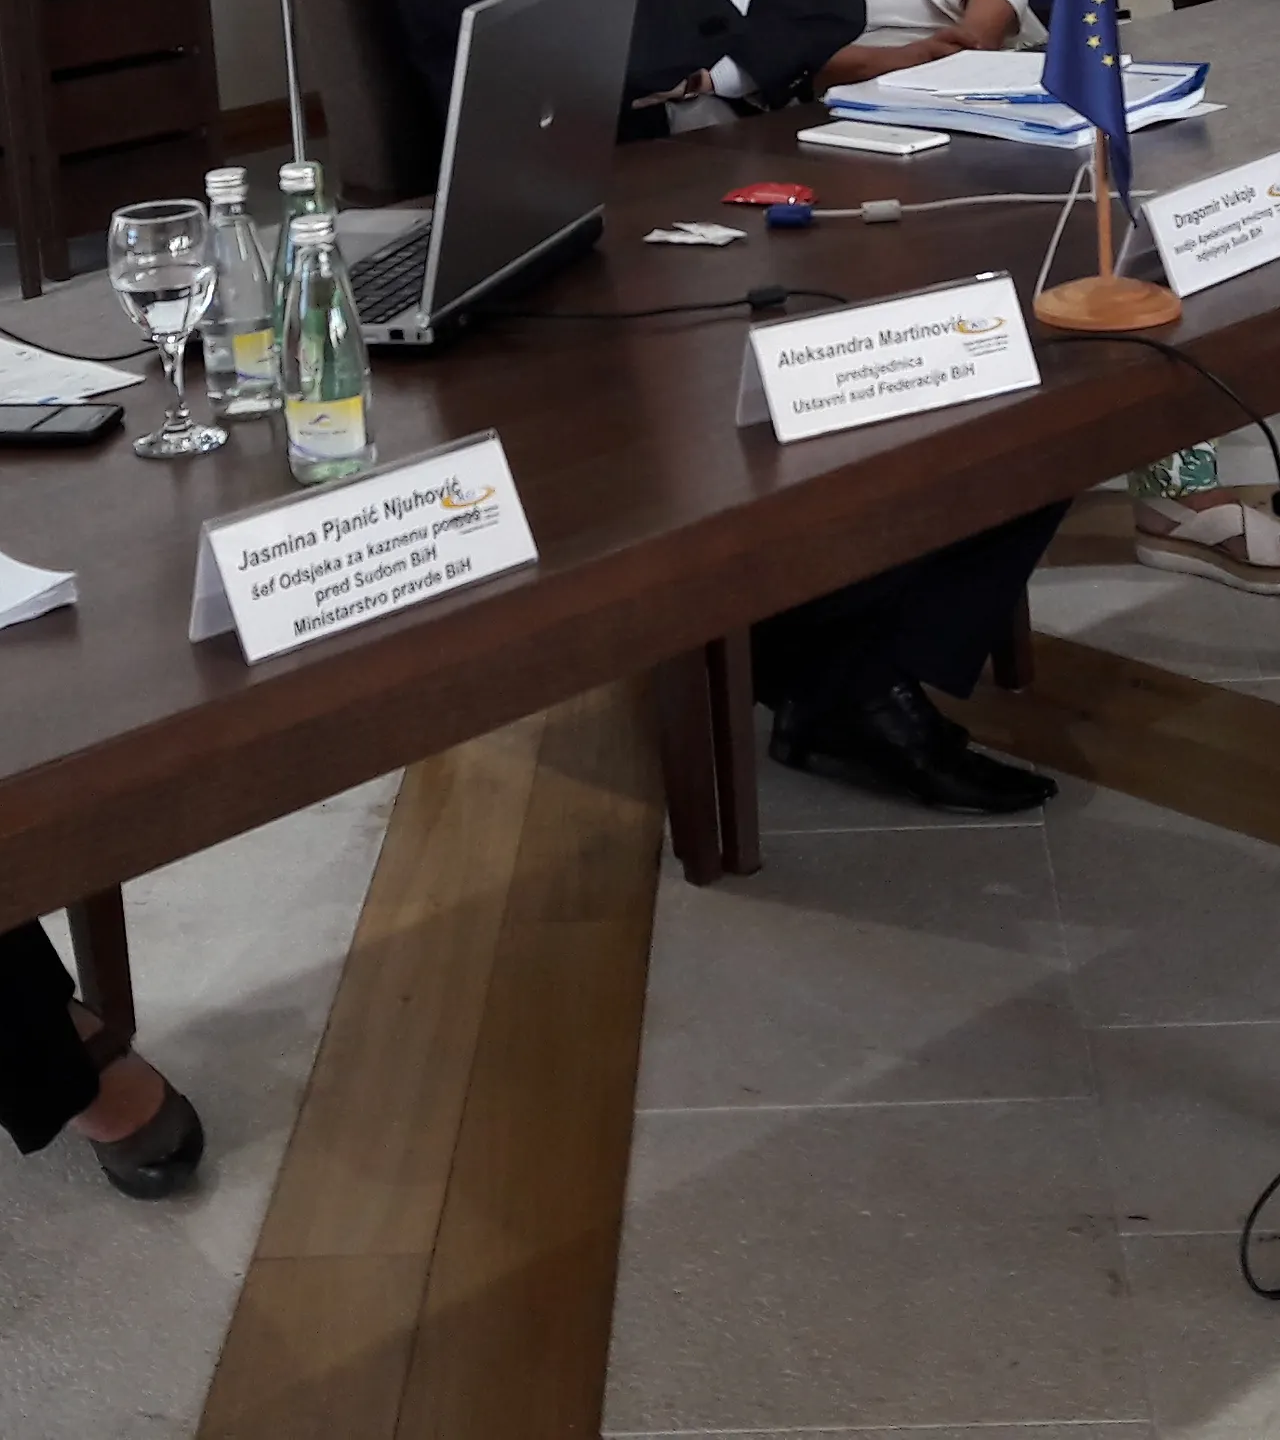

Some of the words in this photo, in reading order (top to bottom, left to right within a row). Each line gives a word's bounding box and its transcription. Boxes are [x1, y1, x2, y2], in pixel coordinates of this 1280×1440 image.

[778, 335, 875, 369] Aleksandra
[835, 355, 924, 387] predsjednica
[792, 390, 847, 415] Ustavni
[850, 383, 876, 404] sud
[878, 370, 948, 397] Federacije
[951, 363, 976, 380] BiH
[238, 528, 317, 572] Jasmina
[321, 505, 379, 543] Pjanić
[384, 475, 462, 522] Njuhović
[251, 581, 275, 601] šef
[278, 557, 342, 590] Odsjeka
[346, 549, 362, 566] za
[368, 527, 428, 558] kaznenu
[314, 577, 350, 608] pred
[354, 557, 407, 588] Sudom
[411, 545, 438, 569] BiH
[293, 592, 388, 637] Ministarstvo
[392, 568, 442, 603] pravde
[445, 556, 472, 581] BiH
